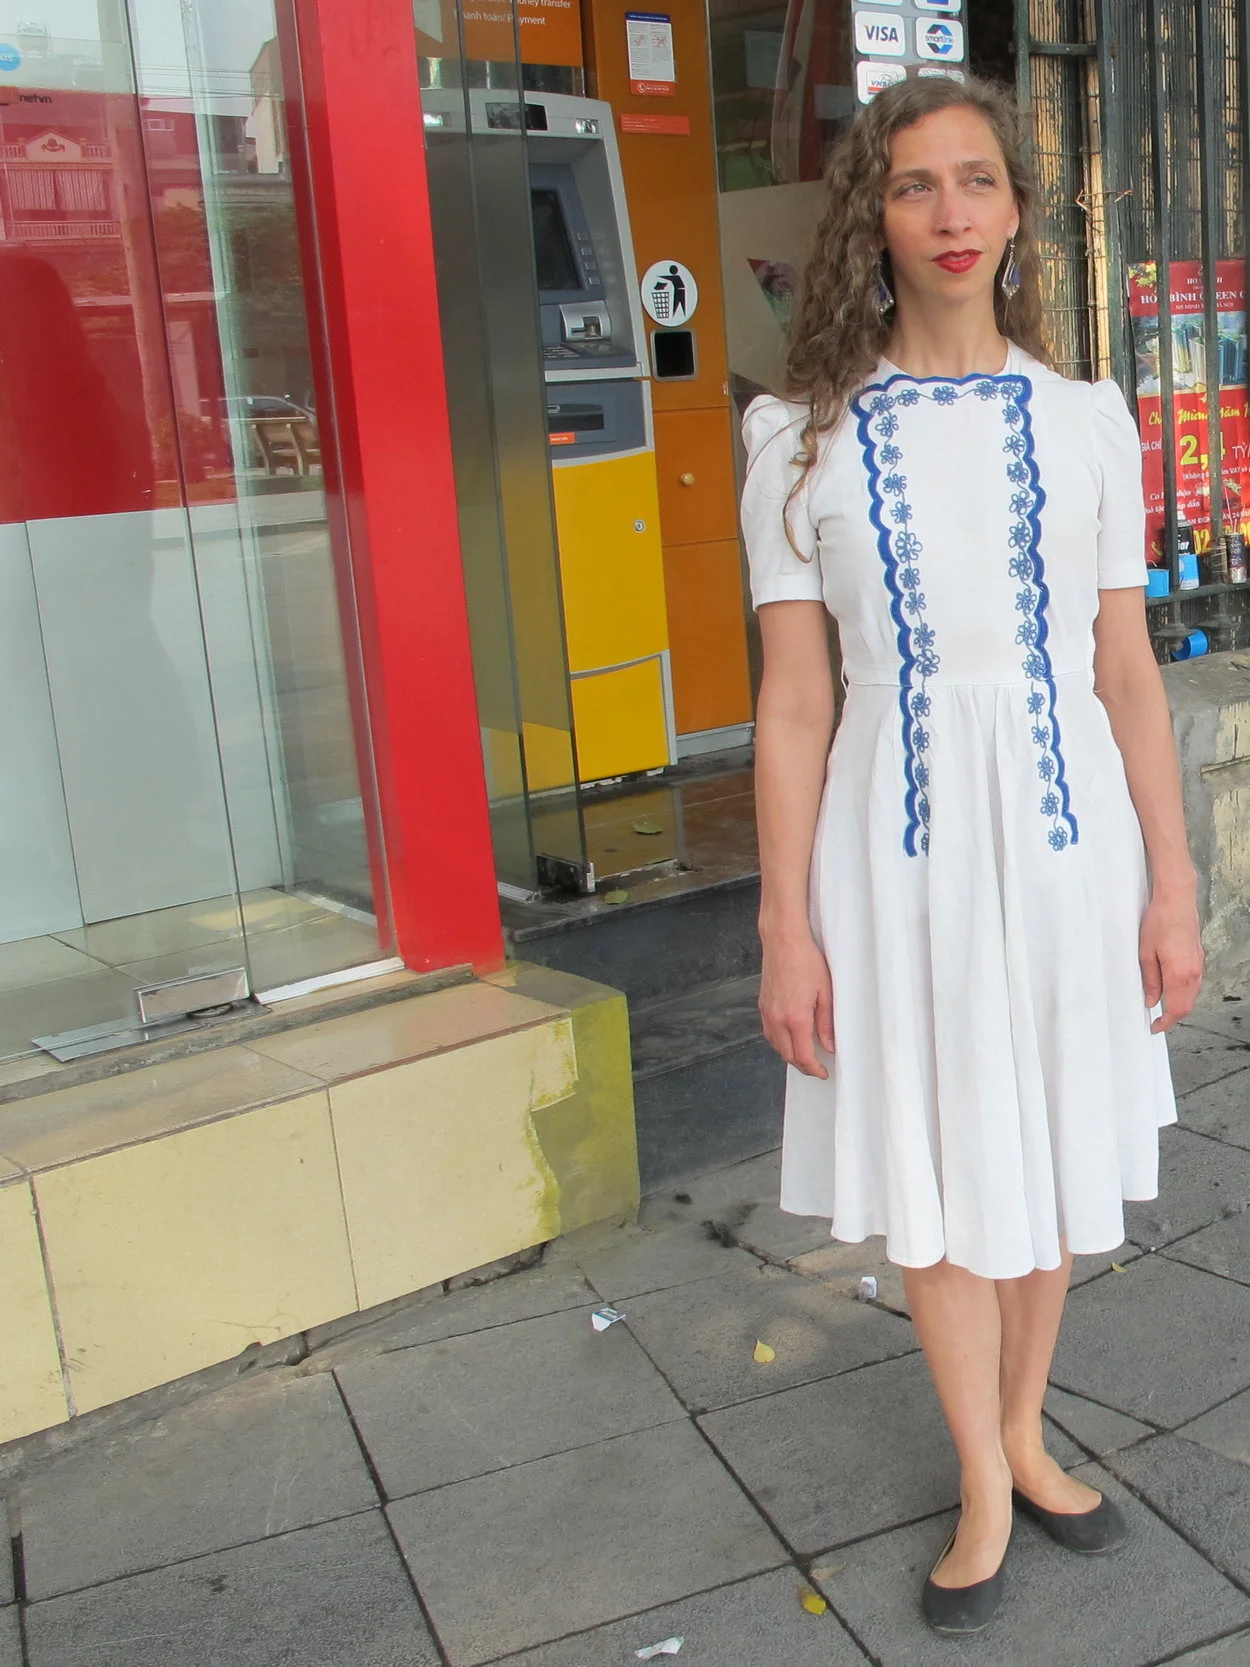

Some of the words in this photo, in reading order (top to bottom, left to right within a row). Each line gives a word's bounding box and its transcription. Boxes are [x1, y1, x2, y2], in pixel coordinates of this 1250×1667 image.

[507, 14, 546, 26] Pyment
[864, 24, 899, 43] VISA
[1169, 290, 1198, 303] BÌNH
